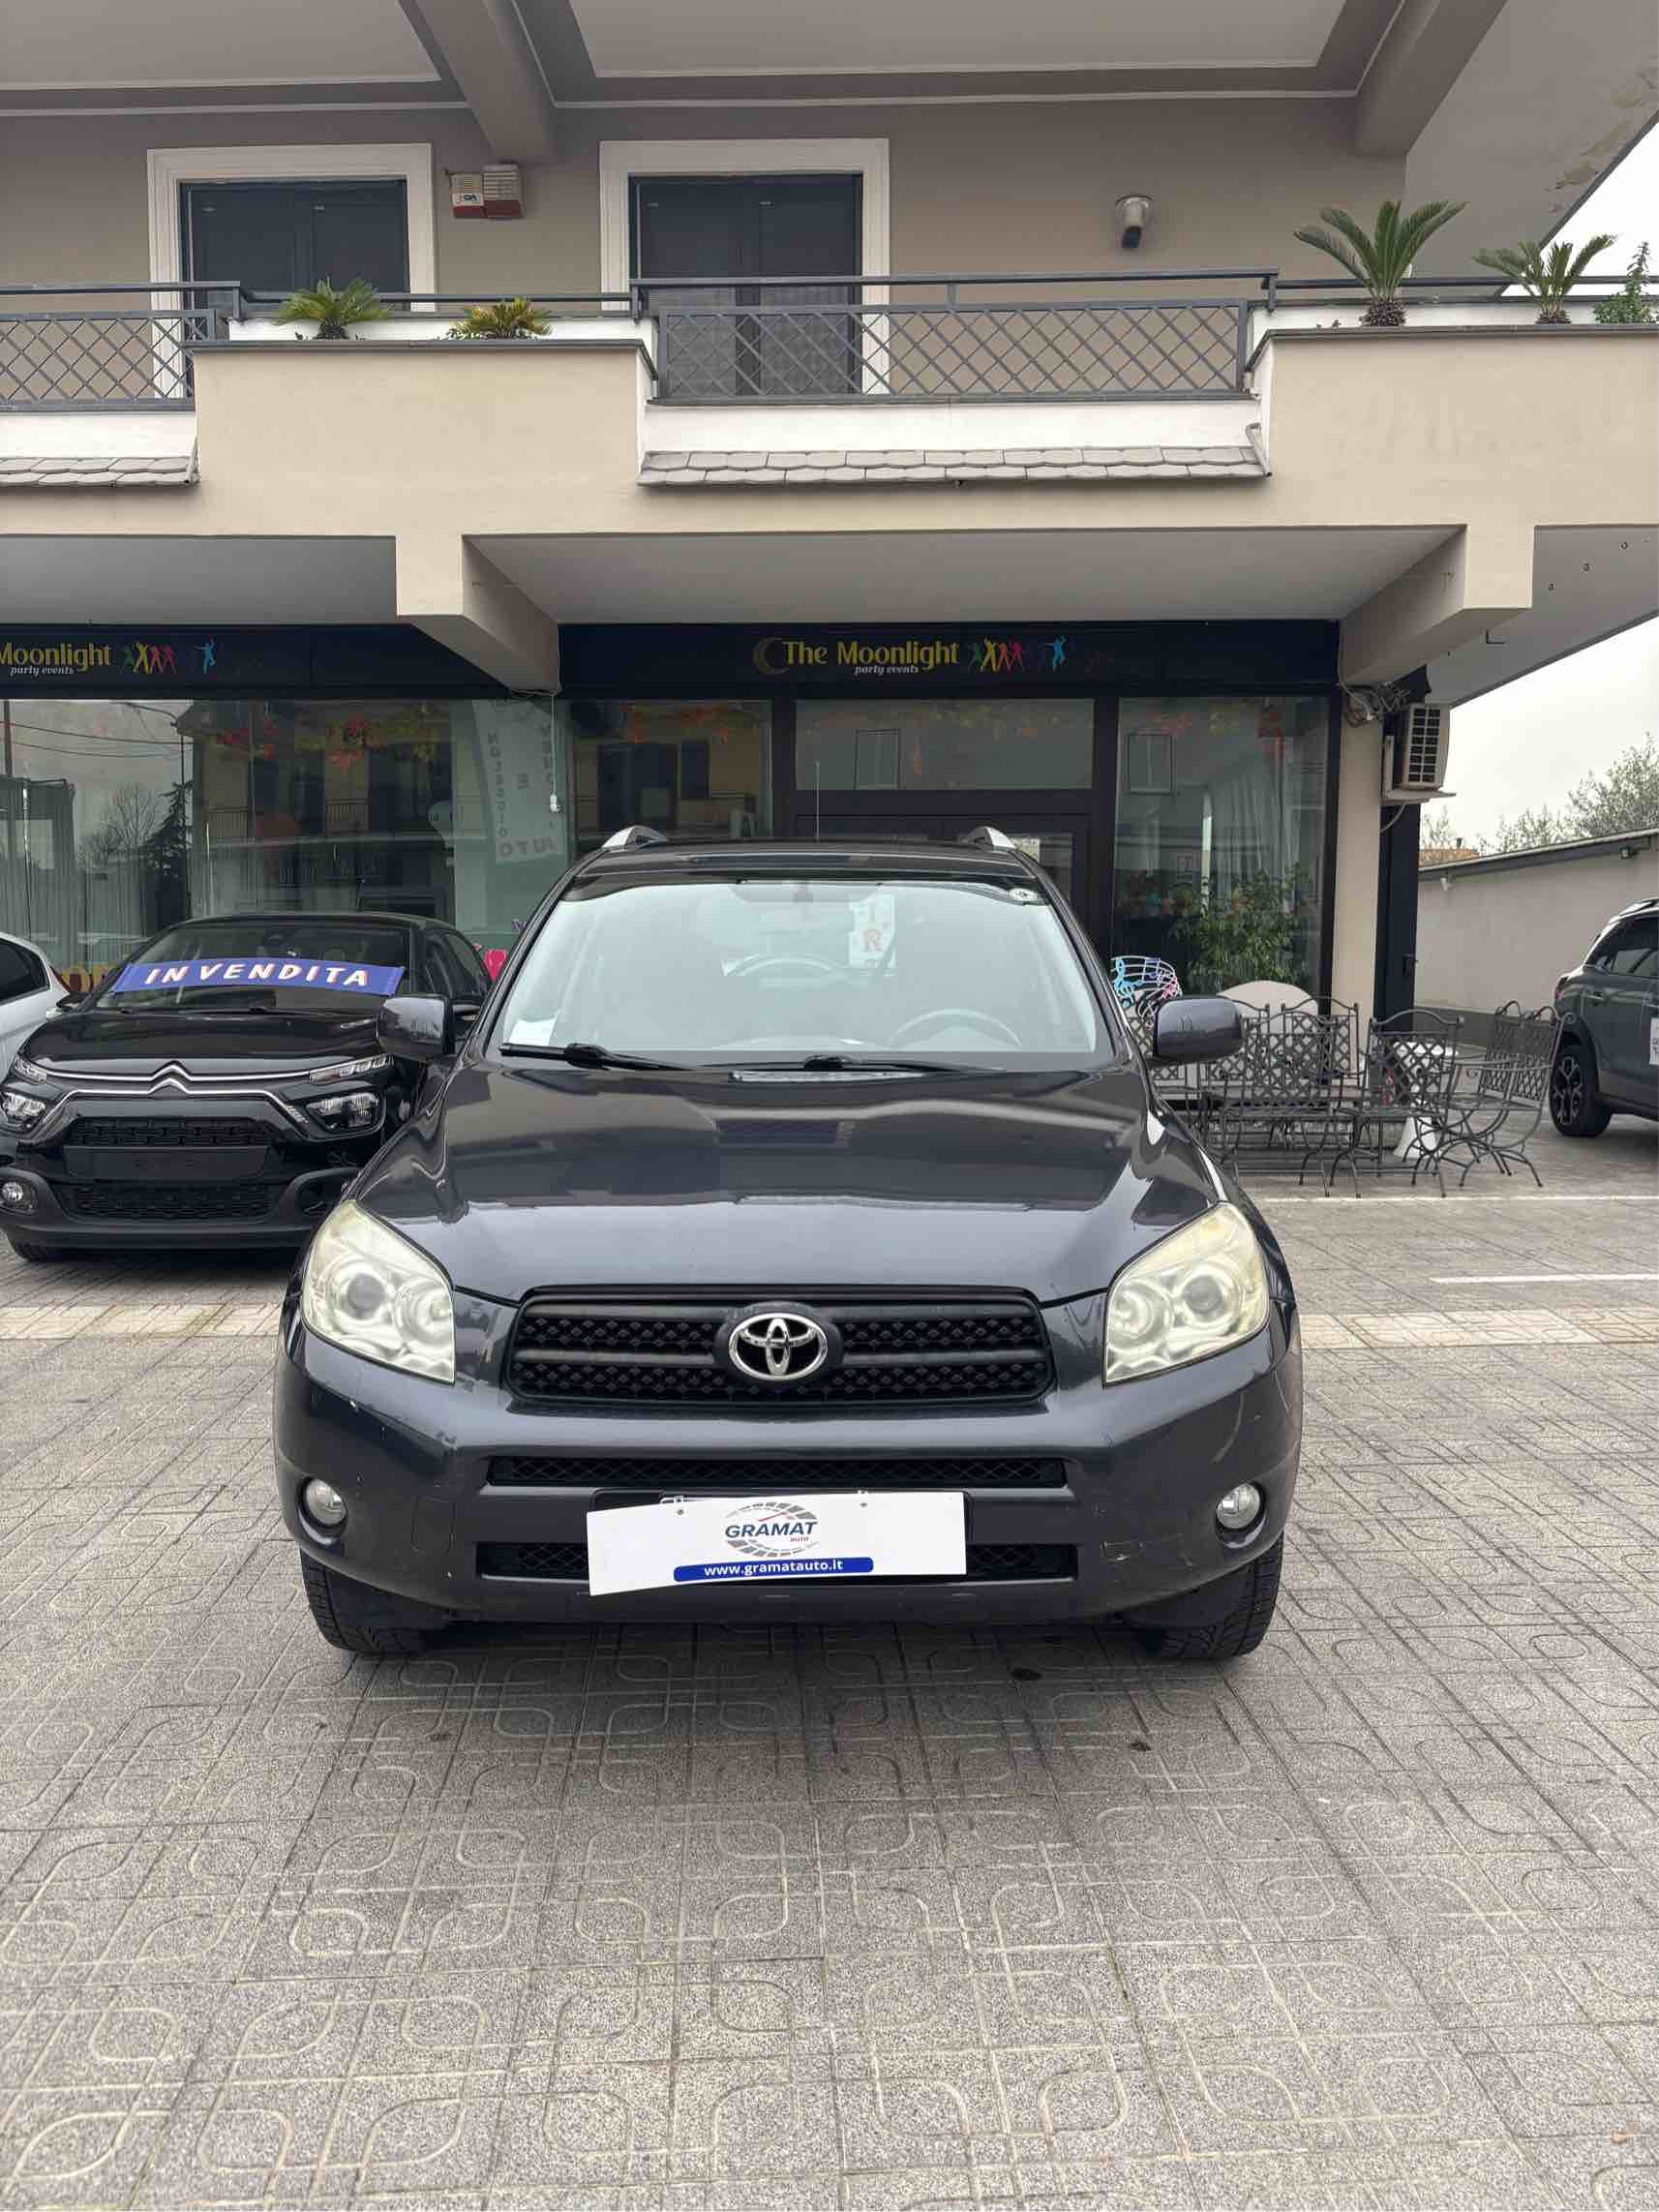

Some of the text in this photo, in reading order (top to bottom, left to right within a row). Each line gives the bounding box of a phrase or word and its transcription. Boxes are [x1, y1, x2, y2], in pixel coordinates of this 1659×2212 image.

[782, 640, 961, 671] The Moonlight
[10, 665, 75, 677] party events
[854, 664, 920, 677] party events
[145, 962, 369, 986] IN VENDITA
[725, 1521, 818, 1539] GRAMAT
[704, 1559, 844, 1577] www.gramatauto.it
